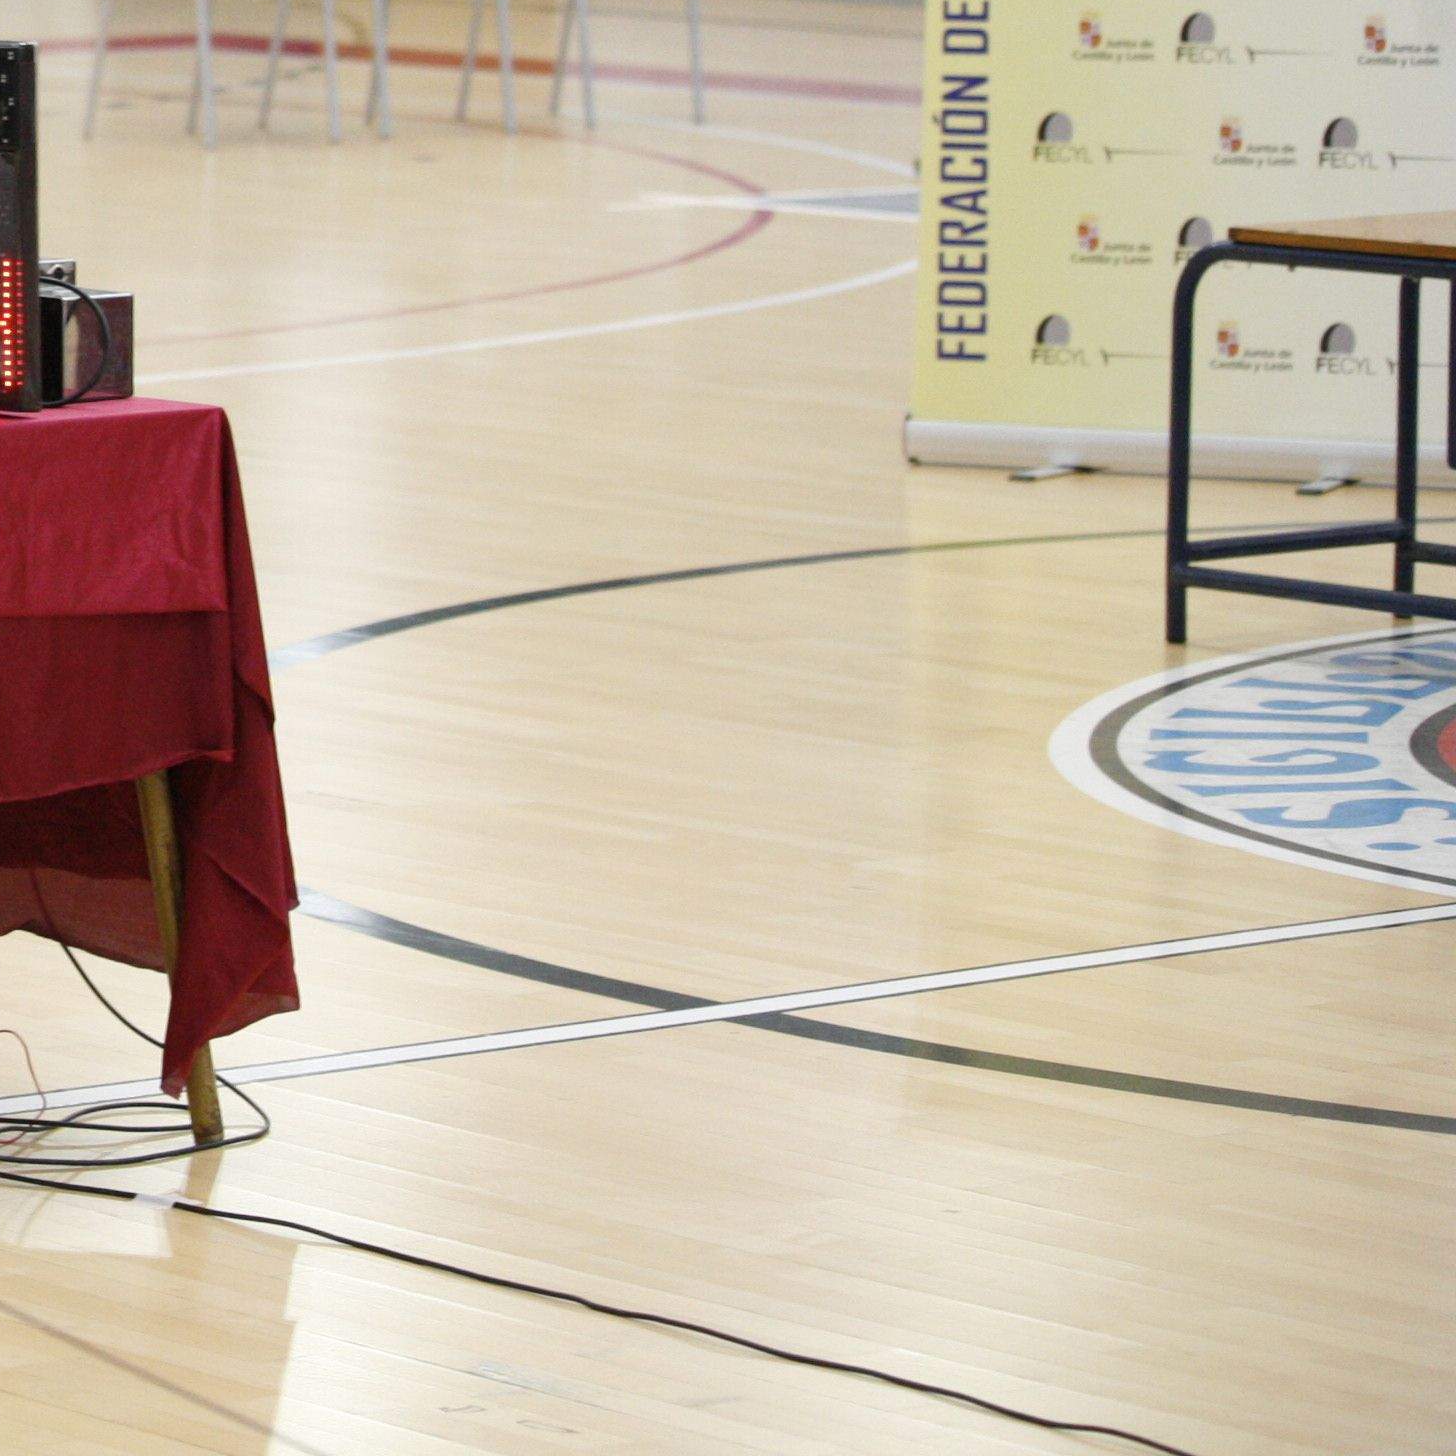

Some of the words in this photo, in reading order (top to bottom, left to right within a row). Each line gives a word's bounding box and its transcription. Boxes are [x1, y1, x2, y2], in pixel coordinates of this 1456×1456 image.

[942, 0, 990, 55] DE
[1318, 150, 1378, 168] FECYL
[932, 73, 990, 361] FEDERACIÓN
[1315, 356, 1372, 374] FECYL
